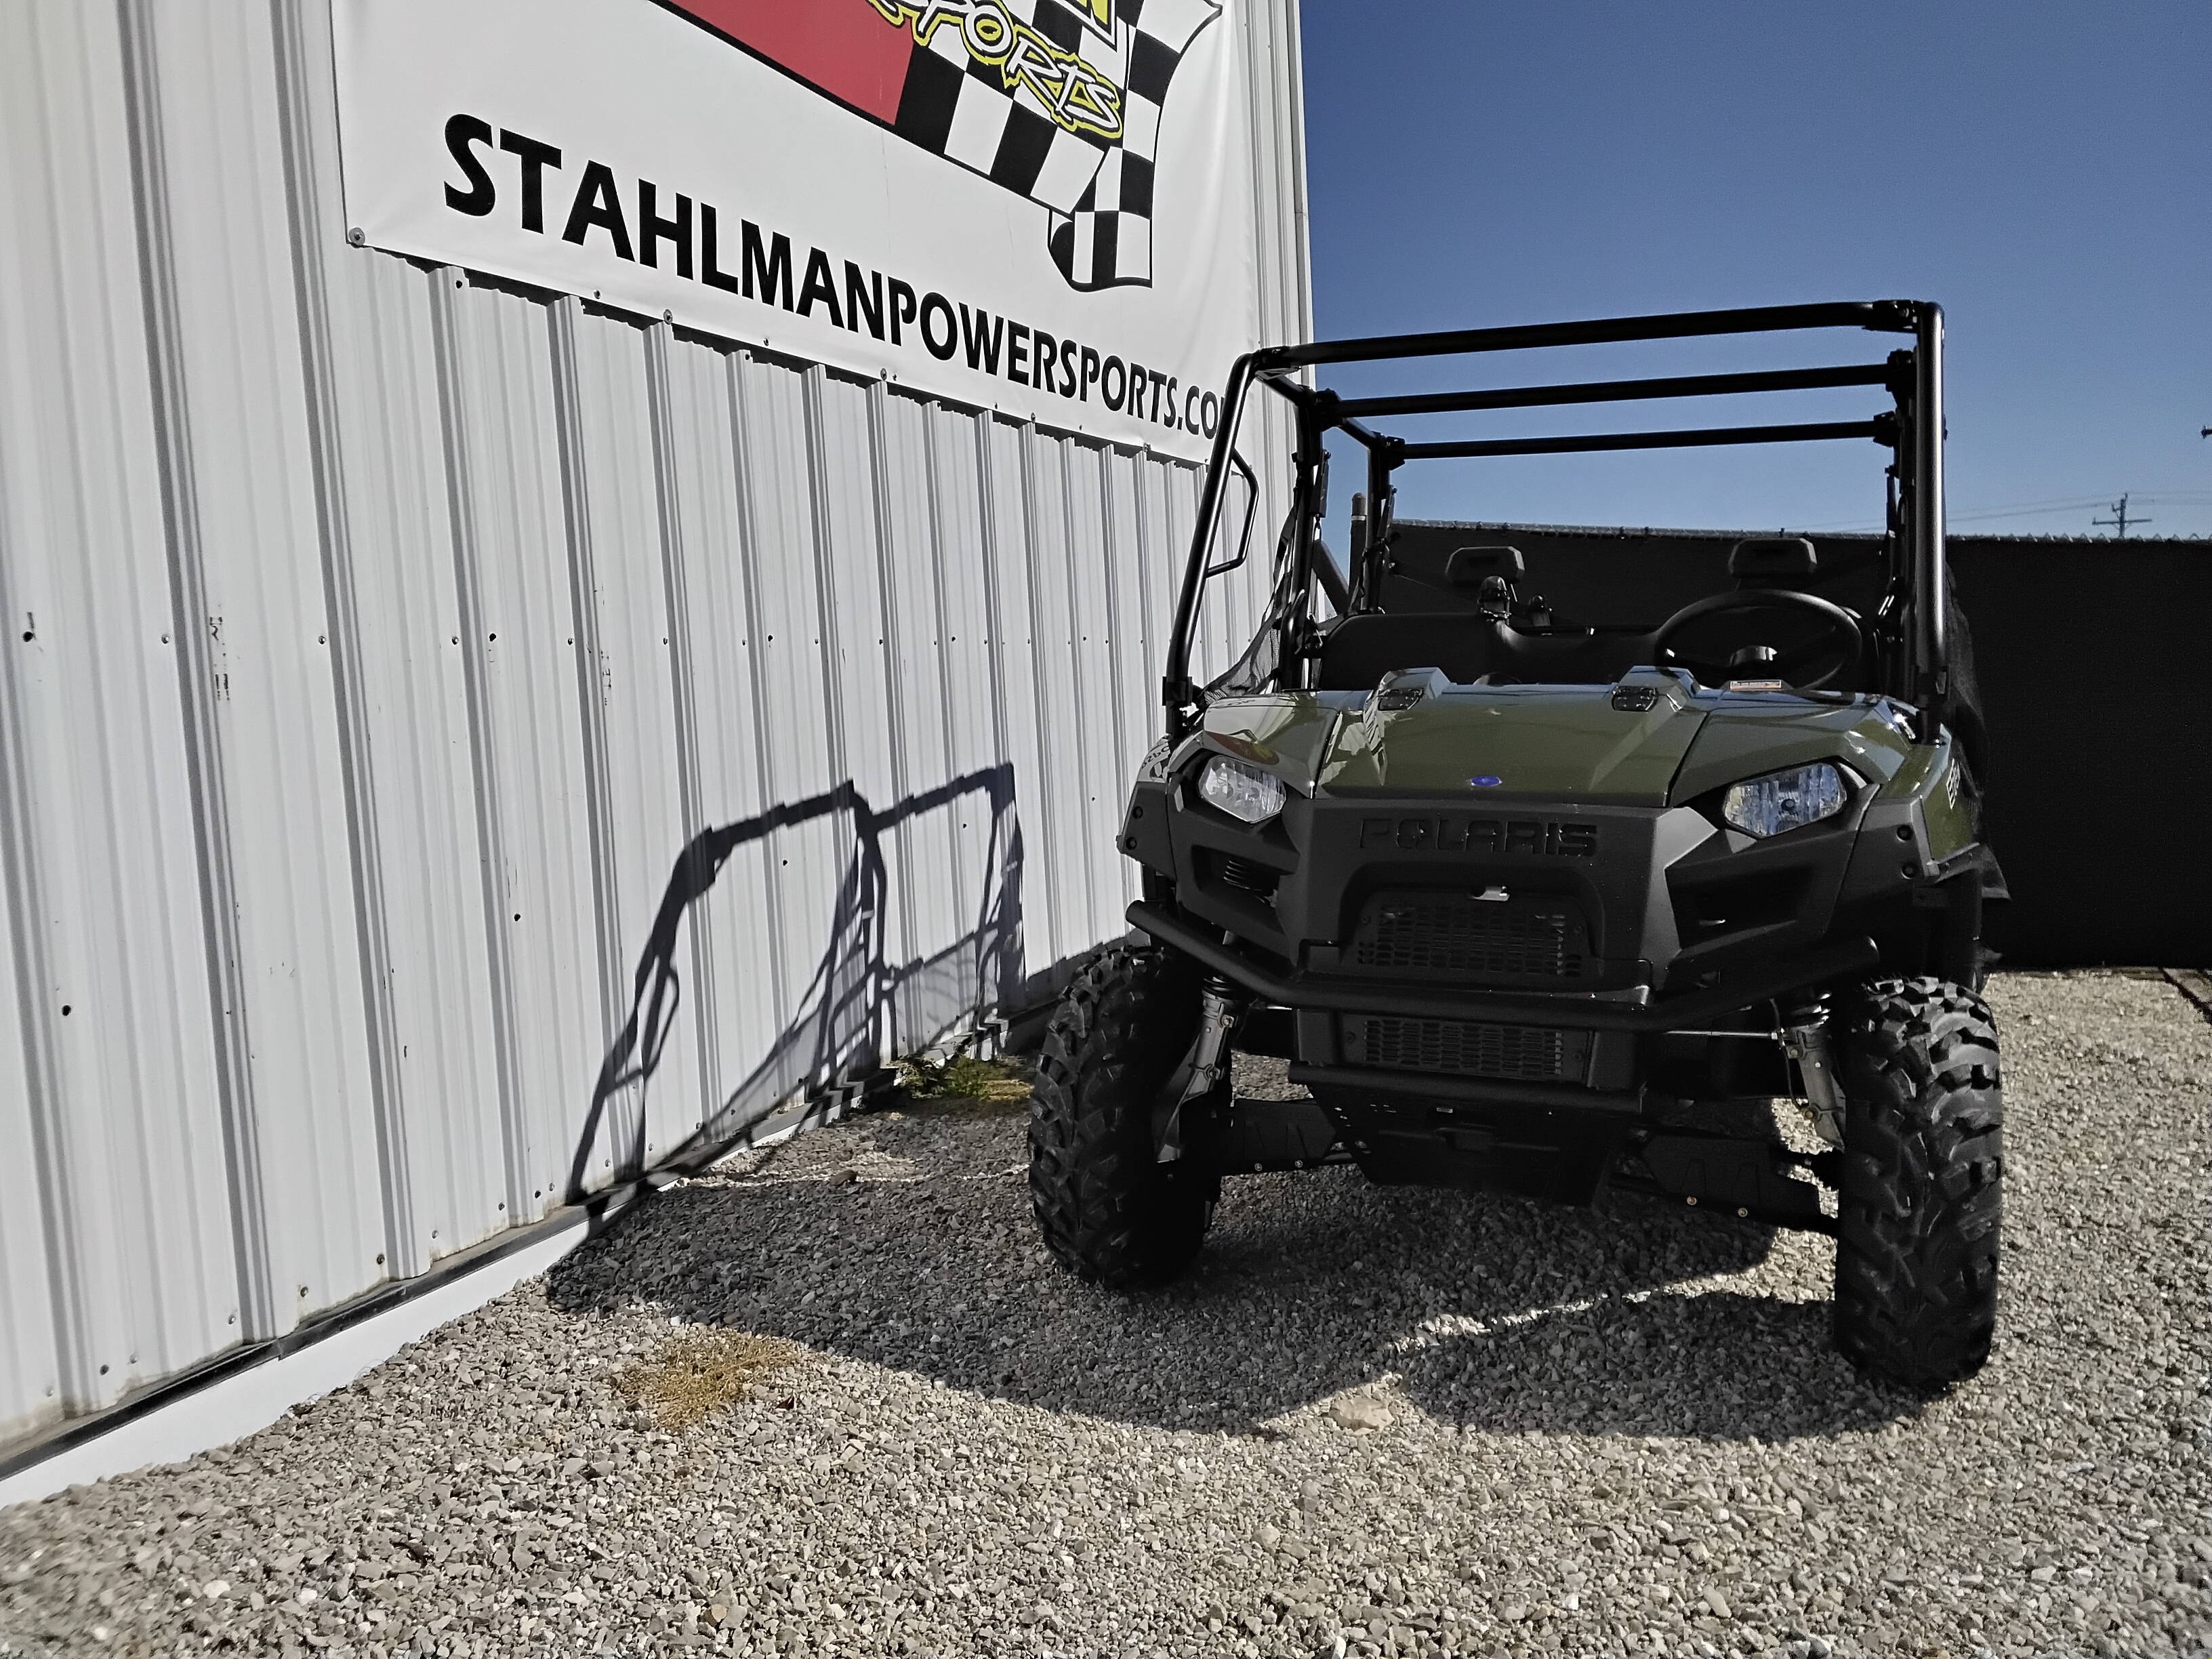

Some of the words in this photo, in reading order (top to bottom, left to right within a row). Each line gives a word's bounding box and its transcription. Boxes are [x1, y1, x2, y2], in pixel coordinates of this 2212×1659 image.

[871, 0, 1122, 138] PORTS
[444, 113, 1225, 440] STAHLMANPOWERSPORTS.CO
[1359, 818, 1597, 857] POLARIS
